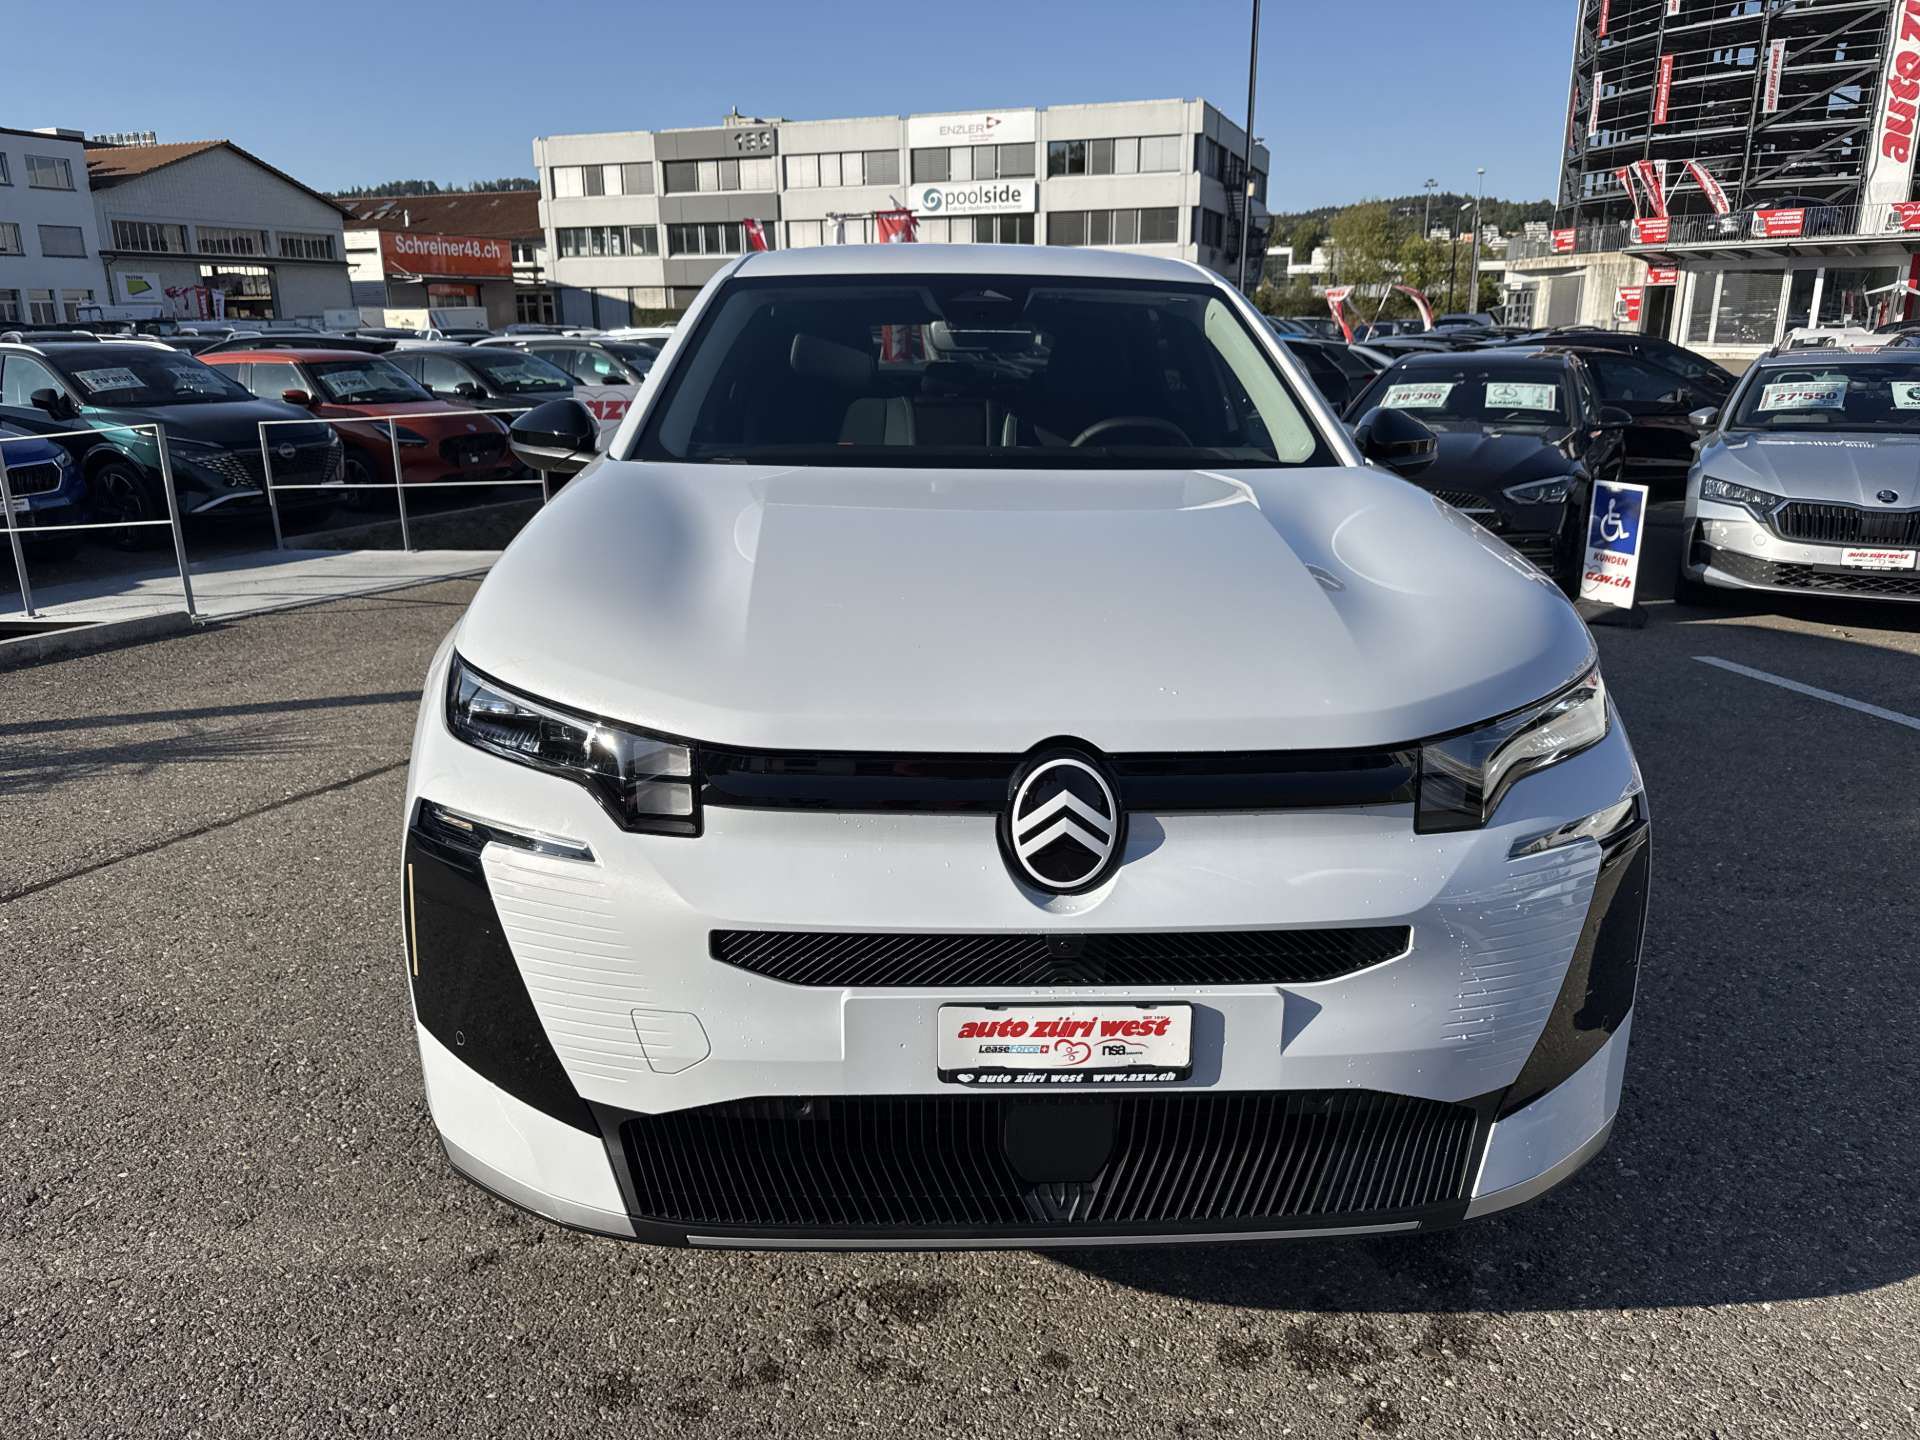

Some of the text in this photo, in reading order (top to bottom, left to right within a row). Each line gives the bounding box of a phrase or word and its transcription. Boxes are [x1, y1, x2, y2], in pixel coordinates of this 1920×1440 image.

[1882, 51, 1920, 163] auto
[939, 123, 985, 136] ENZLER
[945, 185, 1021, 212] poolside
[395, 234, 501, 259] Schreiner48.ch
[1775, 391, 1838, 401] 27'550
[1593, 552, 1629, 566] KUNDEN
[1585, 571, 1631, 588] azw.ch
[958, 1016, 1171, 1038] auto züri west
[978, 1044, 1040, 1054] LeaseForce
[1102, 1045, 1126, 1056] nsa
[978, 1072, 1176, 1083] auto züri west www.azw.ch
